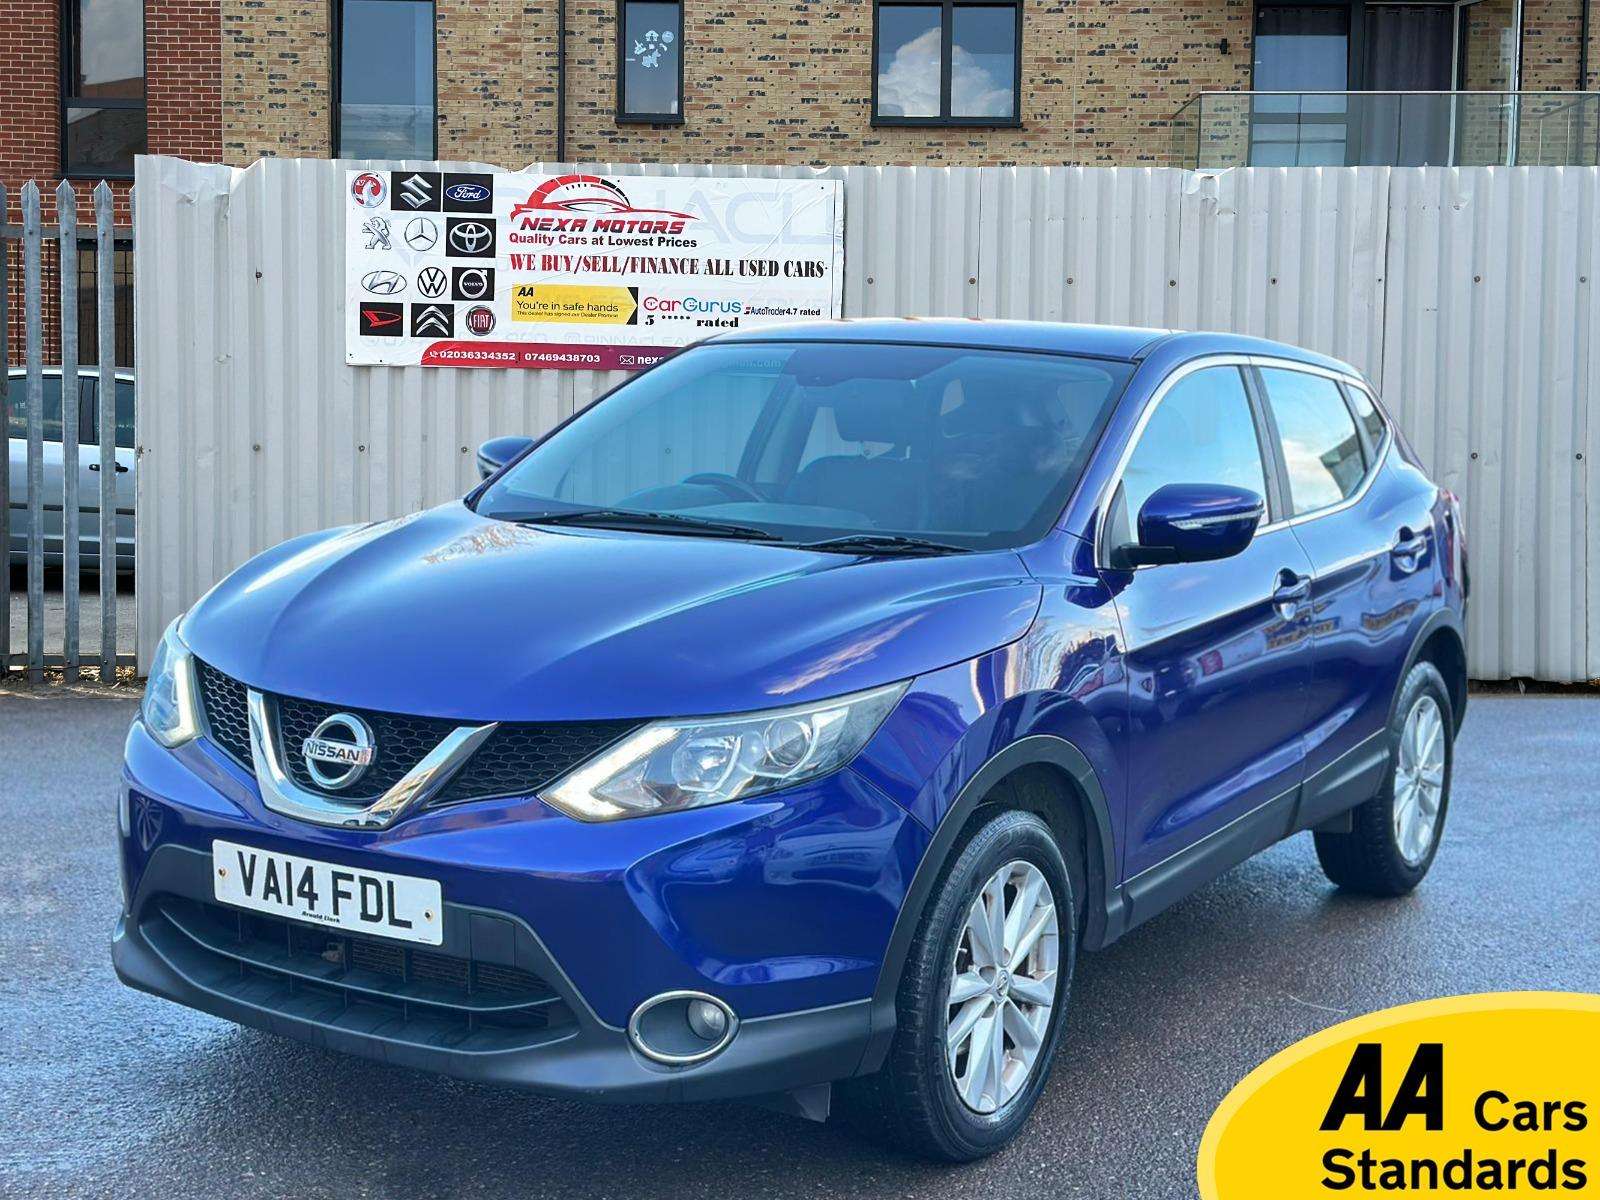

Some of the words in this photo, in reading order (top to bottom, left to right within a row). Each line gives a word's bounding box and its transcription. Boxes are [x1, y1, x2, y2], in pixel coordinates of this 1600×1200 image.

[454, 186, 481, 200] Ford
[520, 217, 588, 232] NEXA
[592, 219, 686, 235] MOTORS
[509, 233, 554, 246] Quality
[559, 234, 588, 245] Cars
[592, 235, 604, 246] at
[609, 235, 654, 247] Lowest
[657, 237, 697, 248] Prices
[509, 253, 536, 271] WE
[704, 258, 734, 276] ALL
[739, 259, 780, 277] USED
[784, 260, 825, 278] CARS
[518, 286, 534, 297] AA
[517, 300, 549, 311] You're
[551, 301, 560, 310] in
[563, 302, 585, 311] safe
[587, 303, 619, 312] hands
[643, 296, 742, 313] CarGurus
[799, 308, 821, 316] rated
[473, 314, 490, 328] FIAT
[645, 315, 655, 326] 5
[696, 317, 739, 328] rated
[524, 353, 601, 363] 07469438703
[305, 740, 360, 761] NISSAN
[237, 850, 319, 911] VA14
[331, 869, 413, 930] FDL
